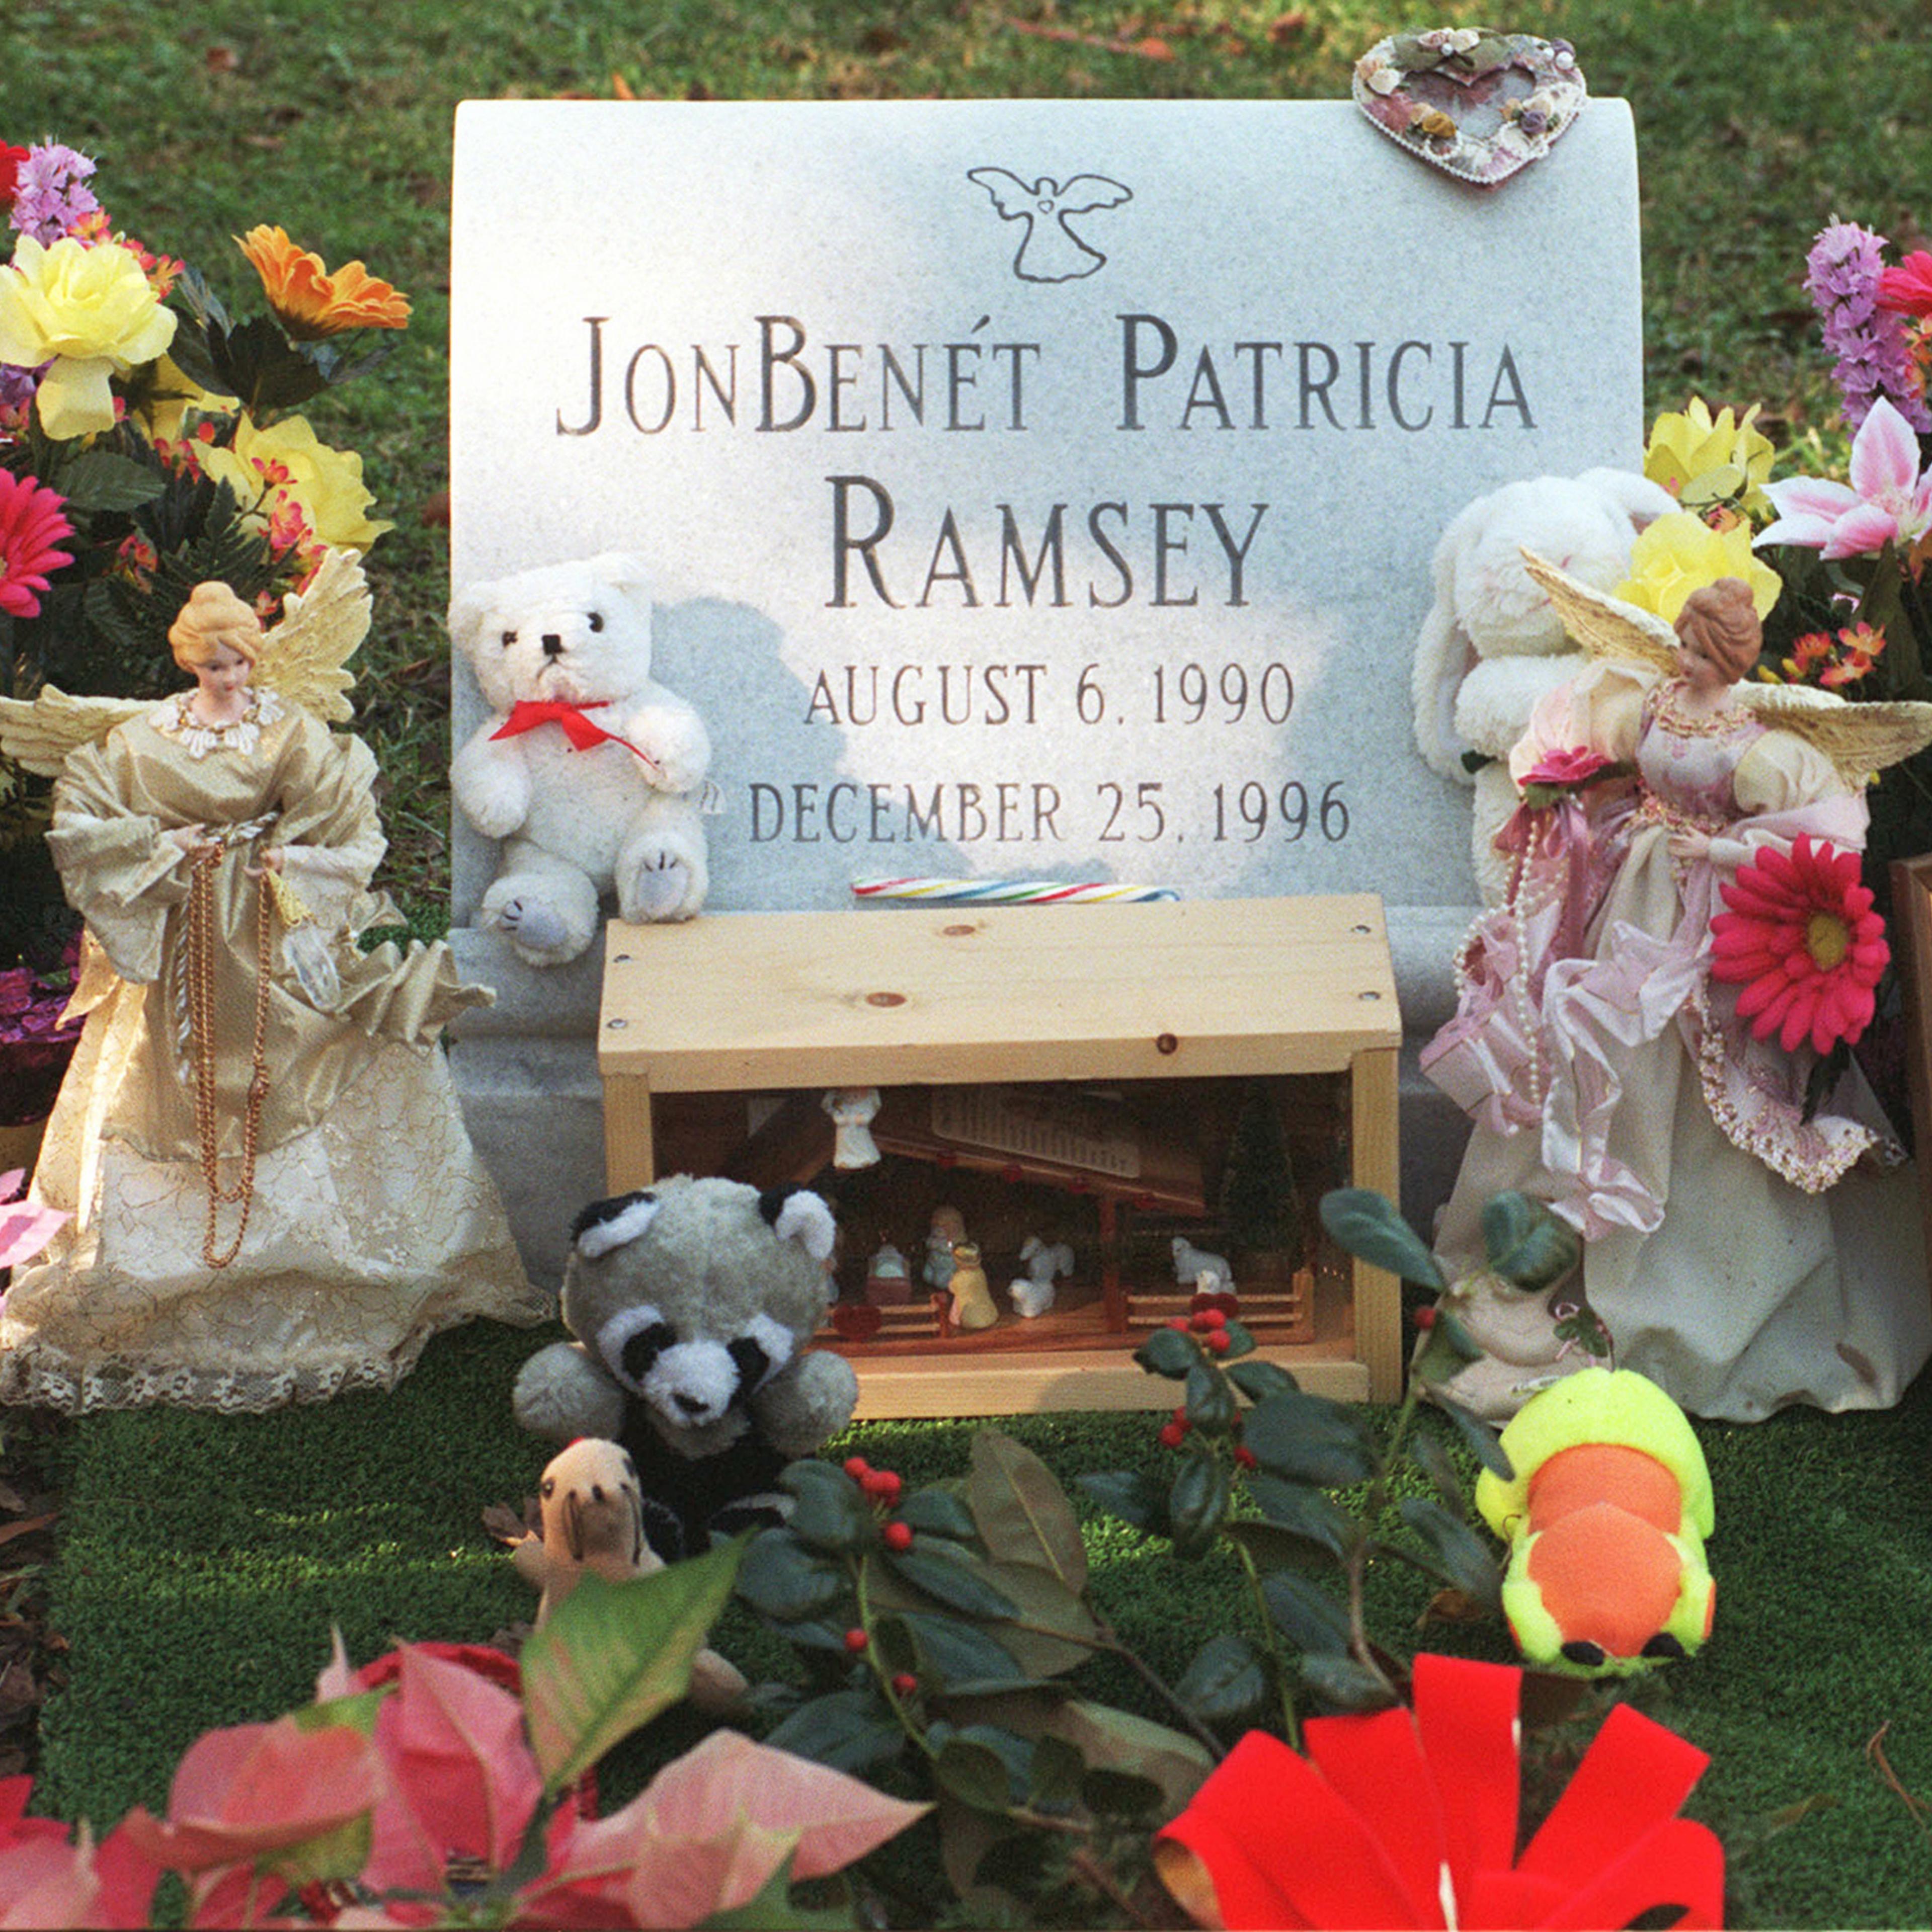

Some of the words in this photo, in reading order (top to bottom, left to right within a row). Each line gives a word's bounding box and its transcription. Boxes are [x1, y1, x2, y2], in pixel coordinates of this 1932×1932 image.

[1114, 312, 1538, 433] PATRICIA
[823, 474, 1270, 610] RAMSEY
[802, 664, 1047, 727] AUGUST
[1153, 662, 1295, 725] 1990
[748, 782, 1066, 844] DECEMBER
[1213, 780, 1350, 844] 1996
